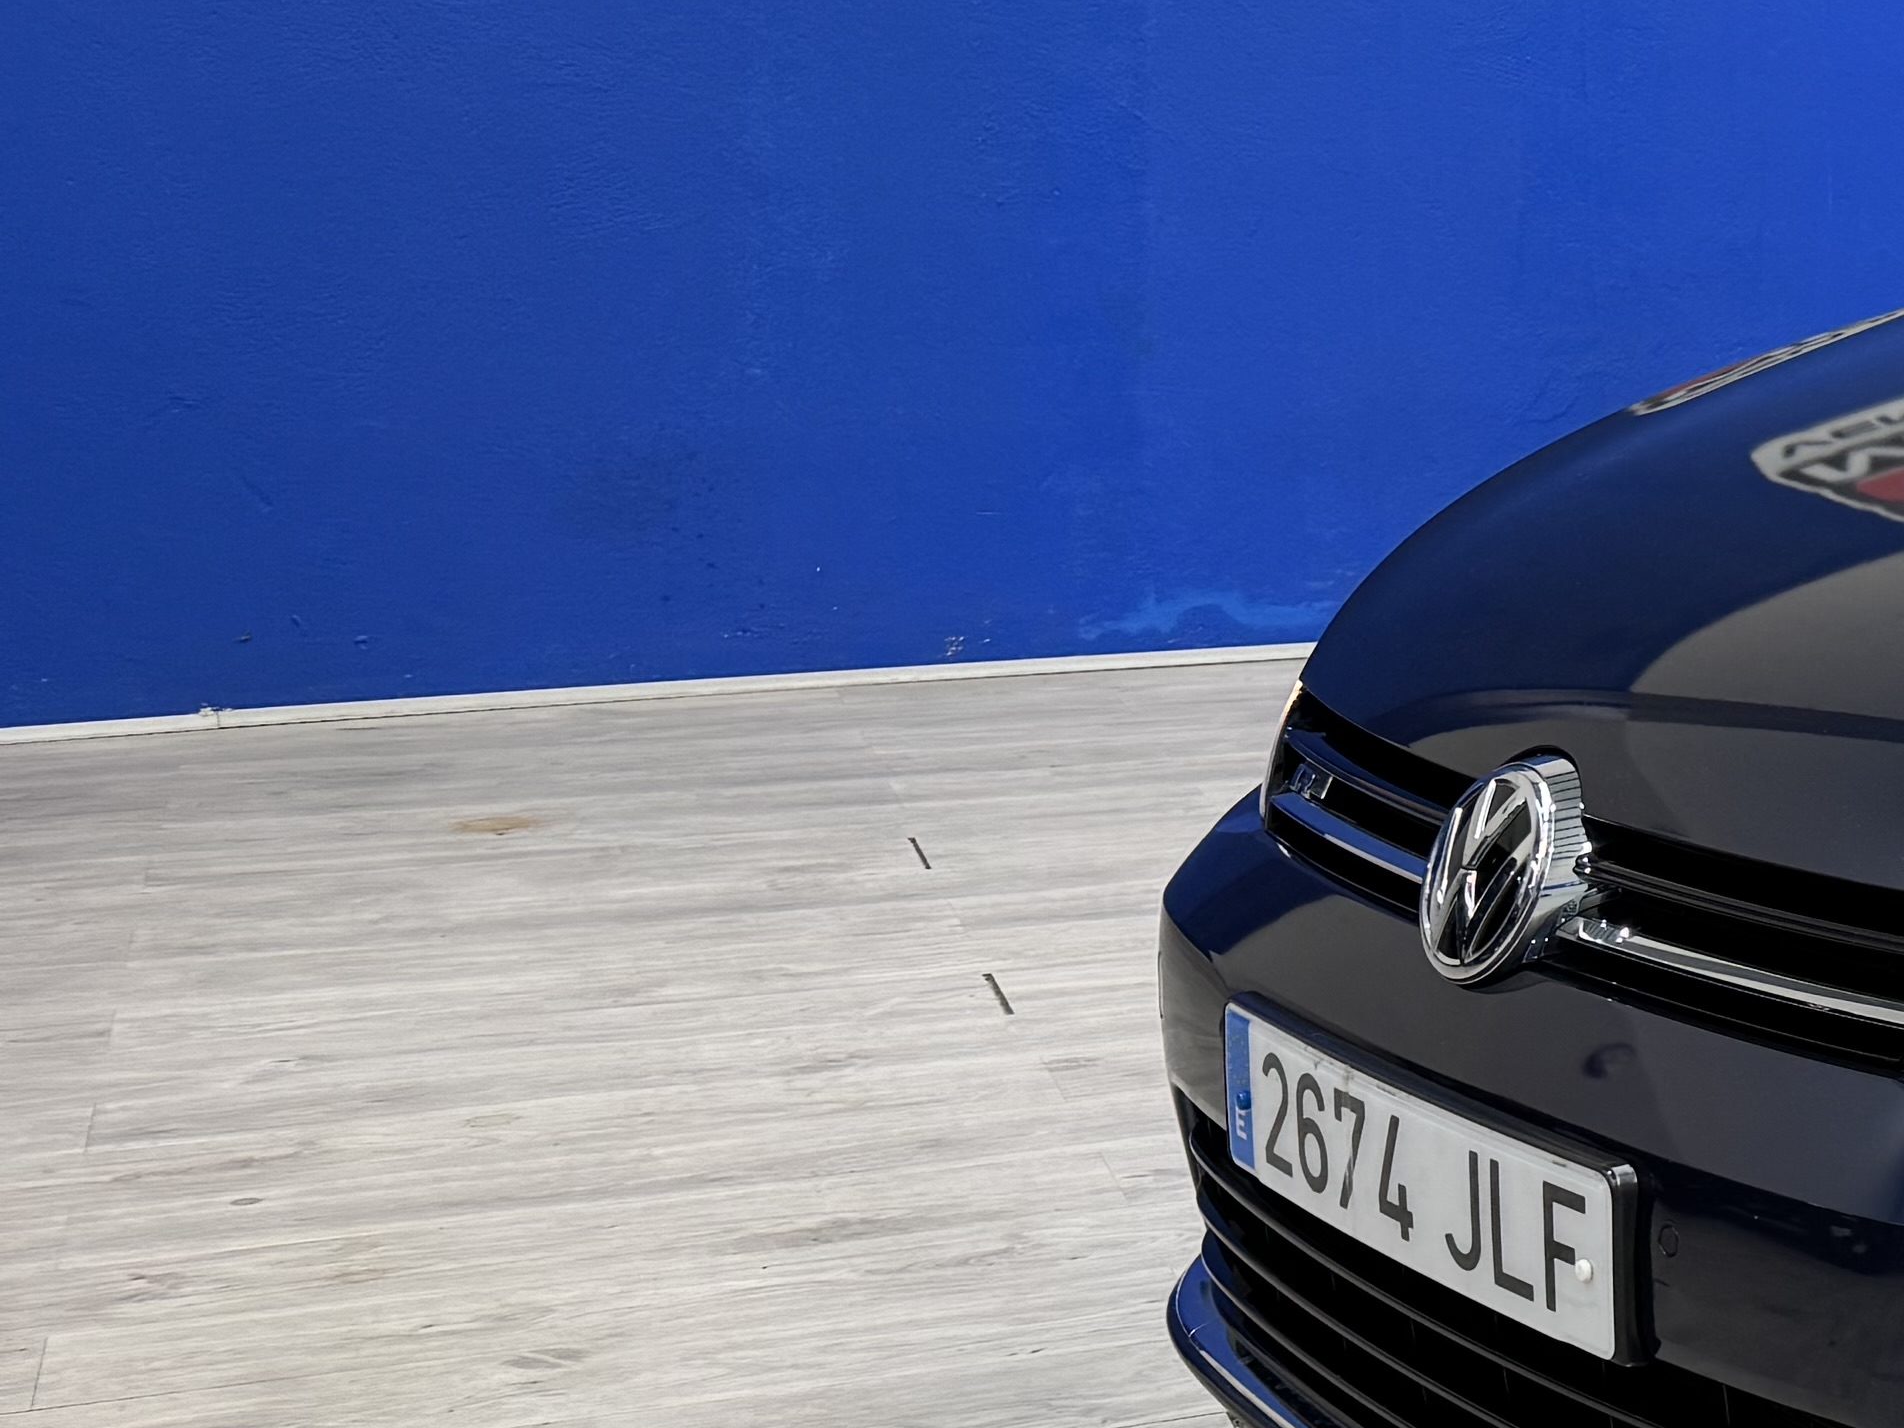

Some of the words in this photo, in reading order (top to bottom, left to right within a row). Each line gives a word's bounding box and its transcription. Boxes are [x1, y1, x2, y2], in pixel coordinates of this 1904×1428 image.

[1236, 1109, 1249, 1139] E
[1261, 1051, 1415, 1244] 2674
[1445, 1149, 1588, 1313] JLF
